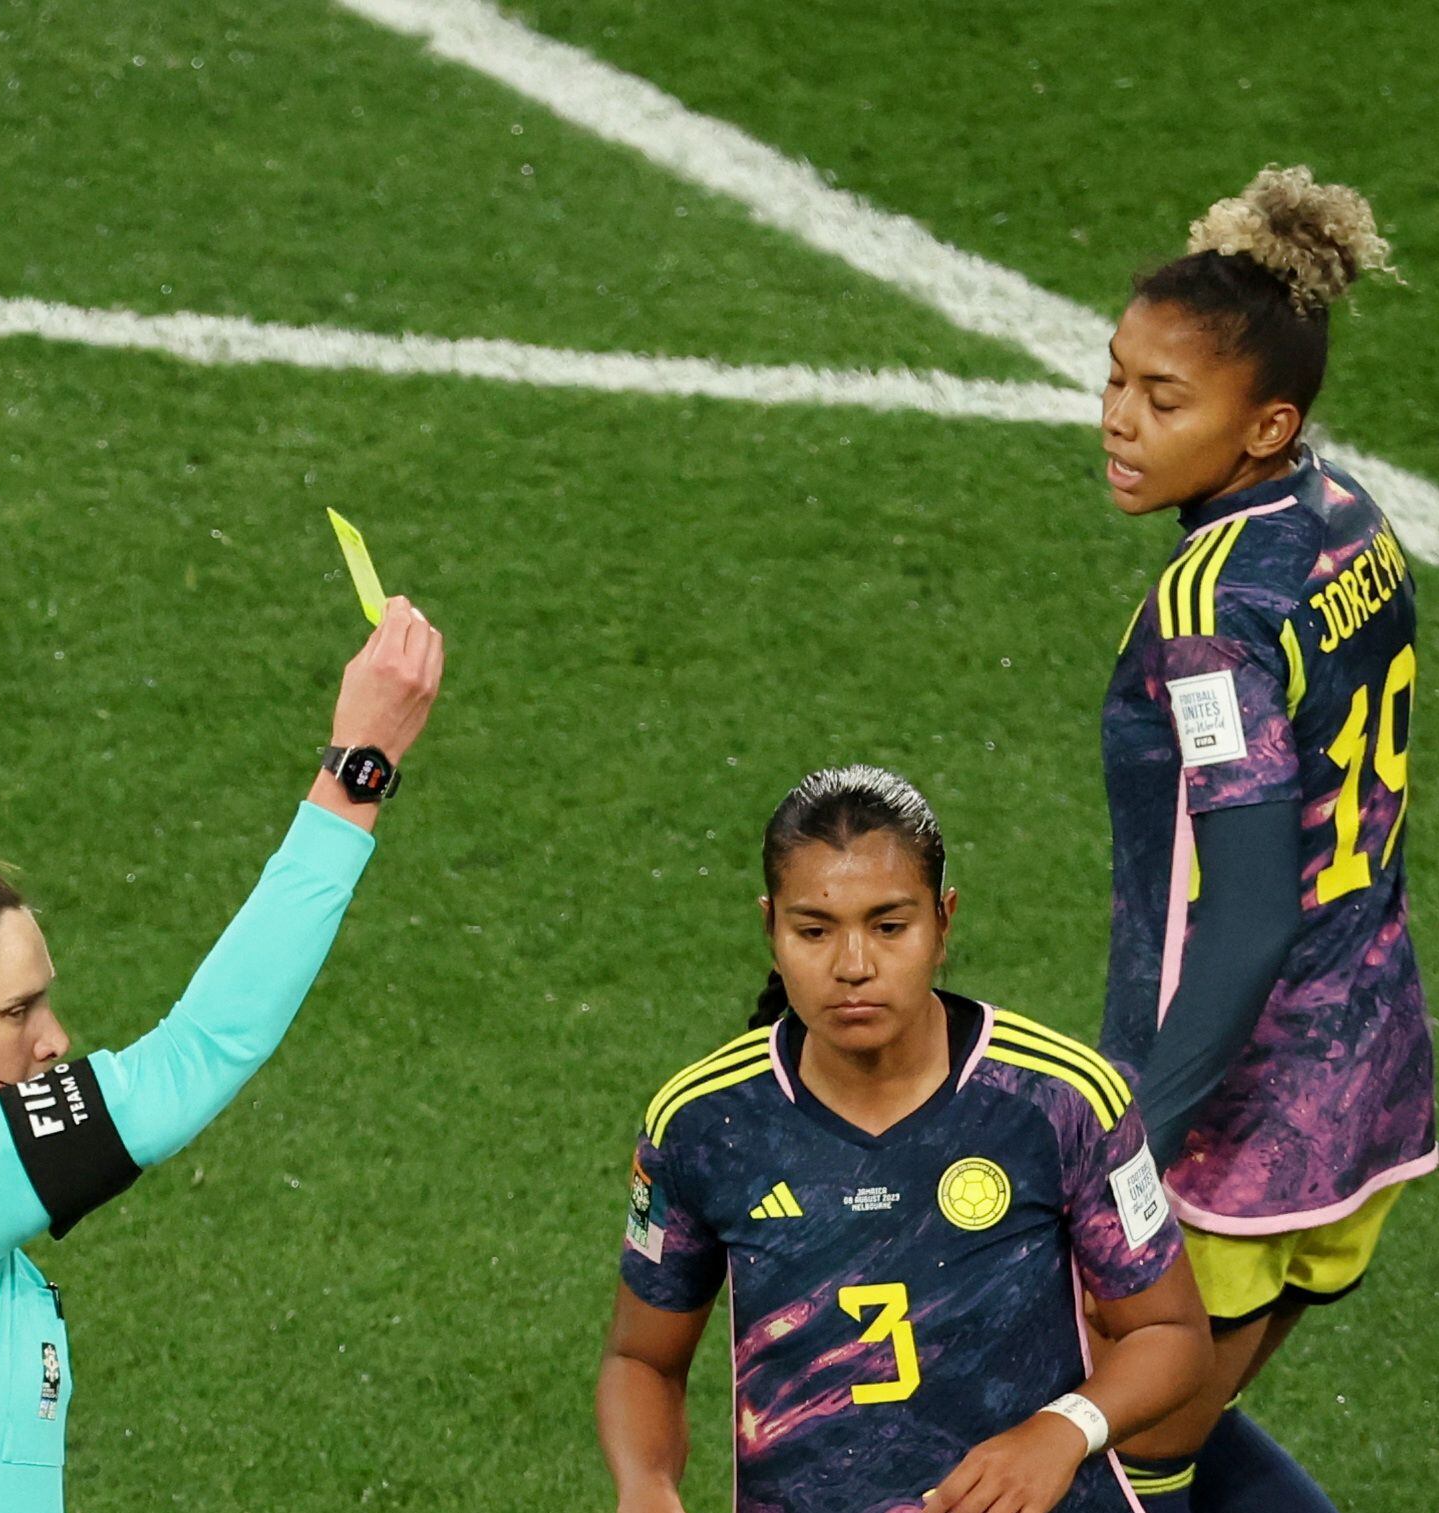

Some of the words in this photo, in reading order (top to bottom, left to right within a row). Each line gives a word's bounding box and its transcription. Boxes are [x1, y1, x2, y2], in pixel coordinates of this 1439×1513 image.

[1179, 689, 1217, 704] FOOTBALL
[1182, 701, 1221, 721] UNITES
[1316, 643, 1416, 905] 19
[60, 1076, 89, 1125] TEAM
[851, 1201, 893, 1212] MELBOURNE
[854, 1194, 881, 1204] AUGUST
[839, 1283, 920, 1405] 3
